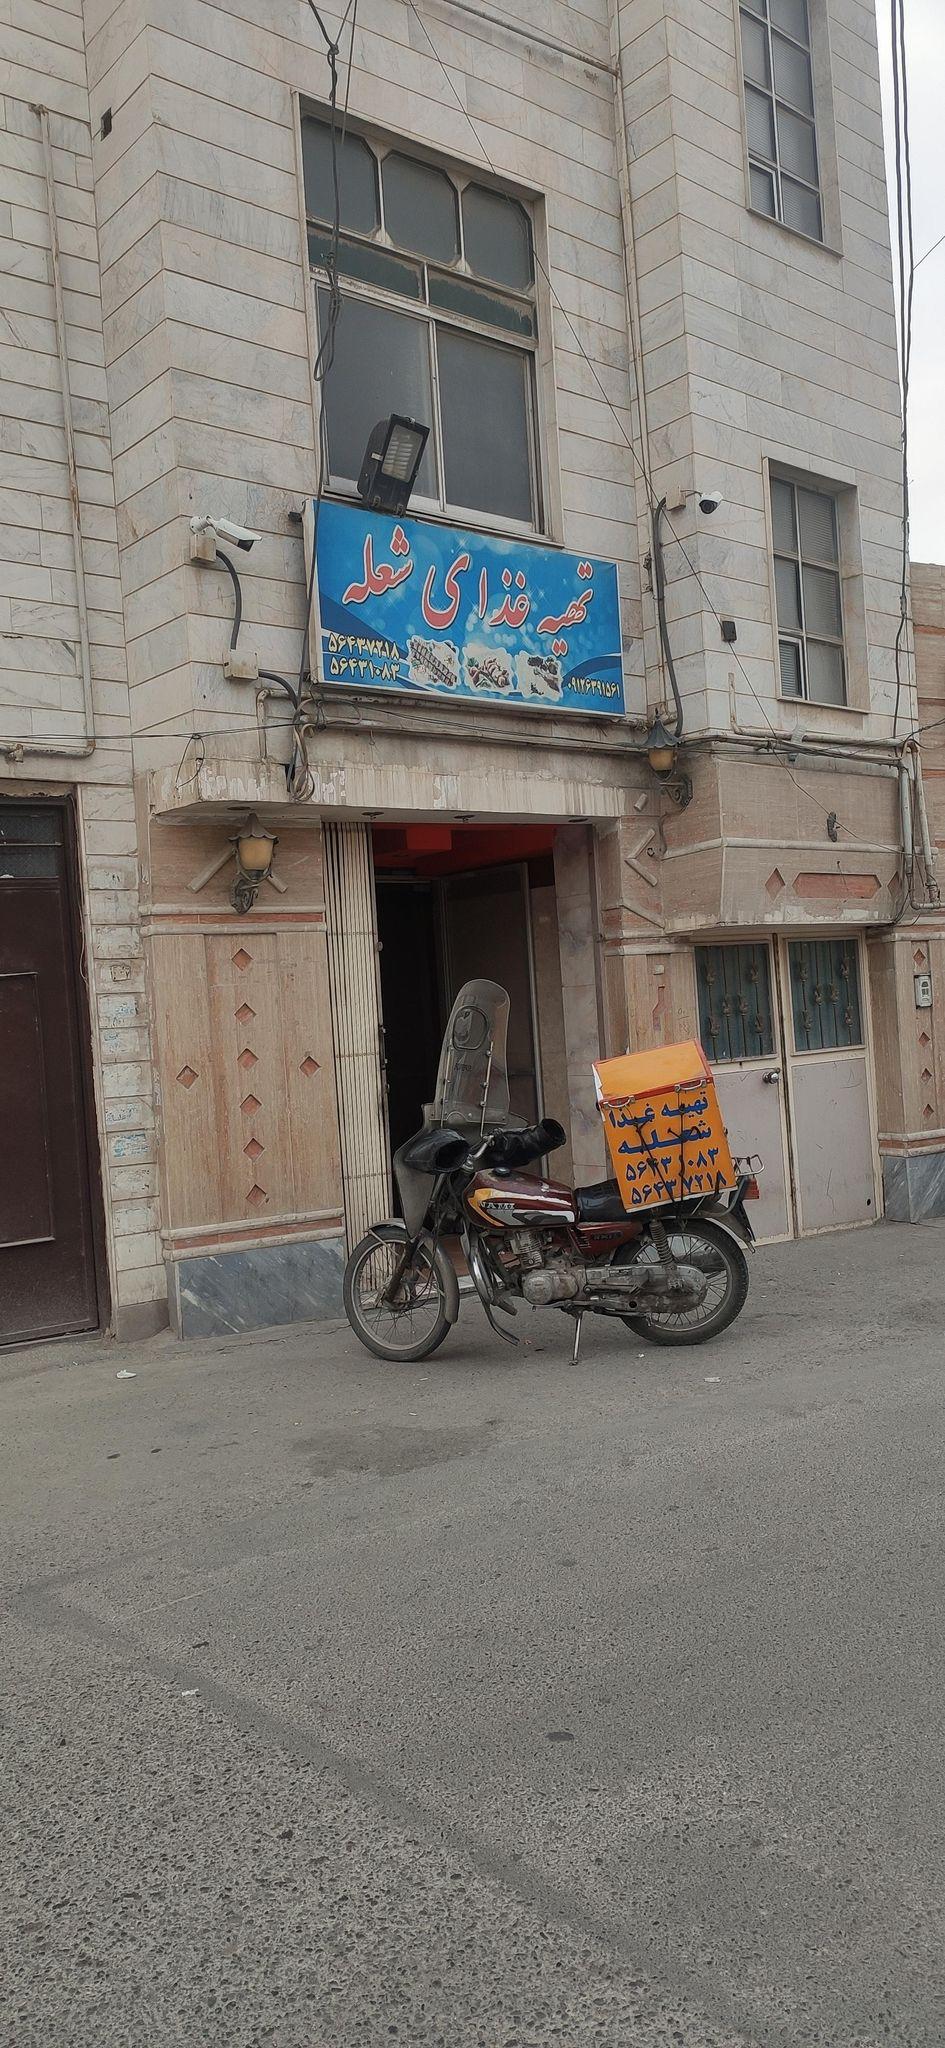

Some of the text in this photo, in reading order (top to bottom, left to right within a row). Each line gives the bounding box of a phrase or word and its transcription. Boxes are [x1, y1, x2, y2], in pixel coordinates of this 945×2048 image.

[342, 524, 414, 606] شعله
[537, 560, 595, 658] تهیه
[329, 632, 400, 660] ۵۶۴۳۷۲۱۸
[330, 656, 400, 681] ۵۶۴۳۱۰۸۳
[609, 1091, 709, 1129] تهیه غذا
[618, 1119, 712, 1155] شعله
